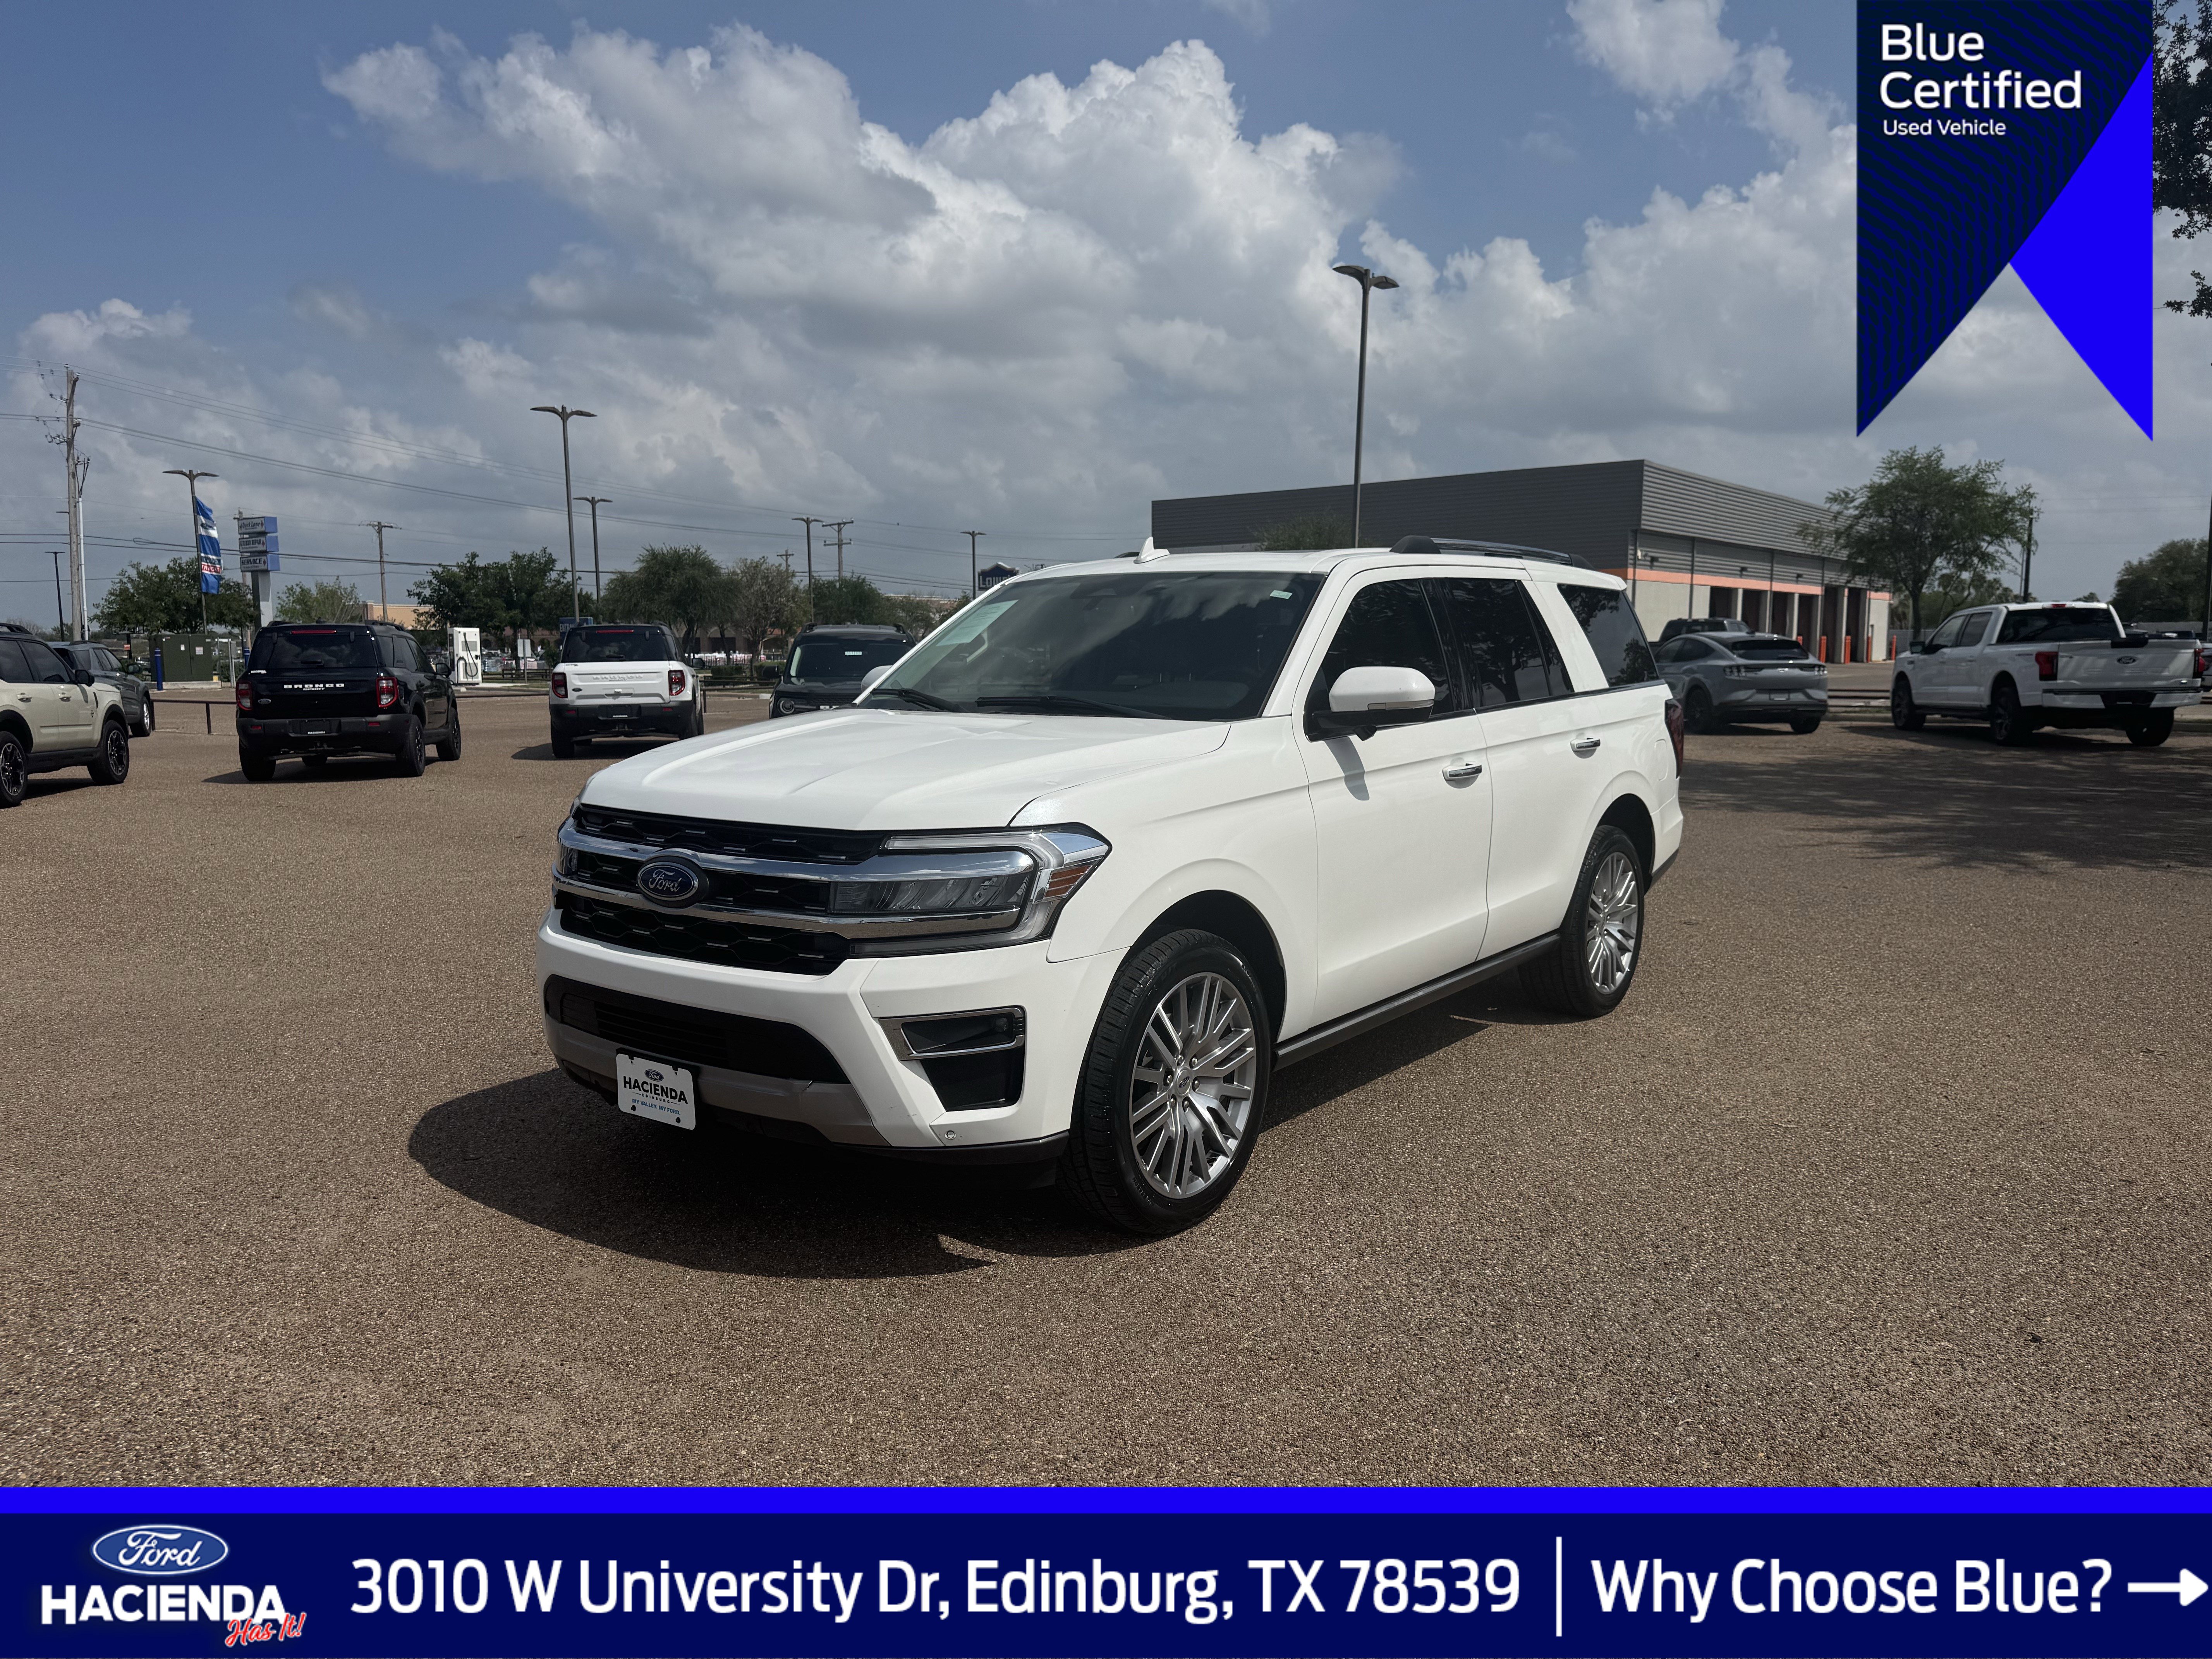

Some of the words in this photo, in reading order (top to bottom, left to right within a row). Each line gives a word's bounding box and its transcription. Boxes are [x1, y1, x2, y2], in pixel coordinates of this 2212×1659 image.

[648, 869, 682, 892] Ford
[649, 1070, 661, 1080] Ford
[623, 1075, 689, 1104] HACIENDA
[642, 1093, 670, 1104] EDINBURG
[641, 1100, 658, 1109] VALLEY.
[667, 1108, 681, 1116] FORD.
